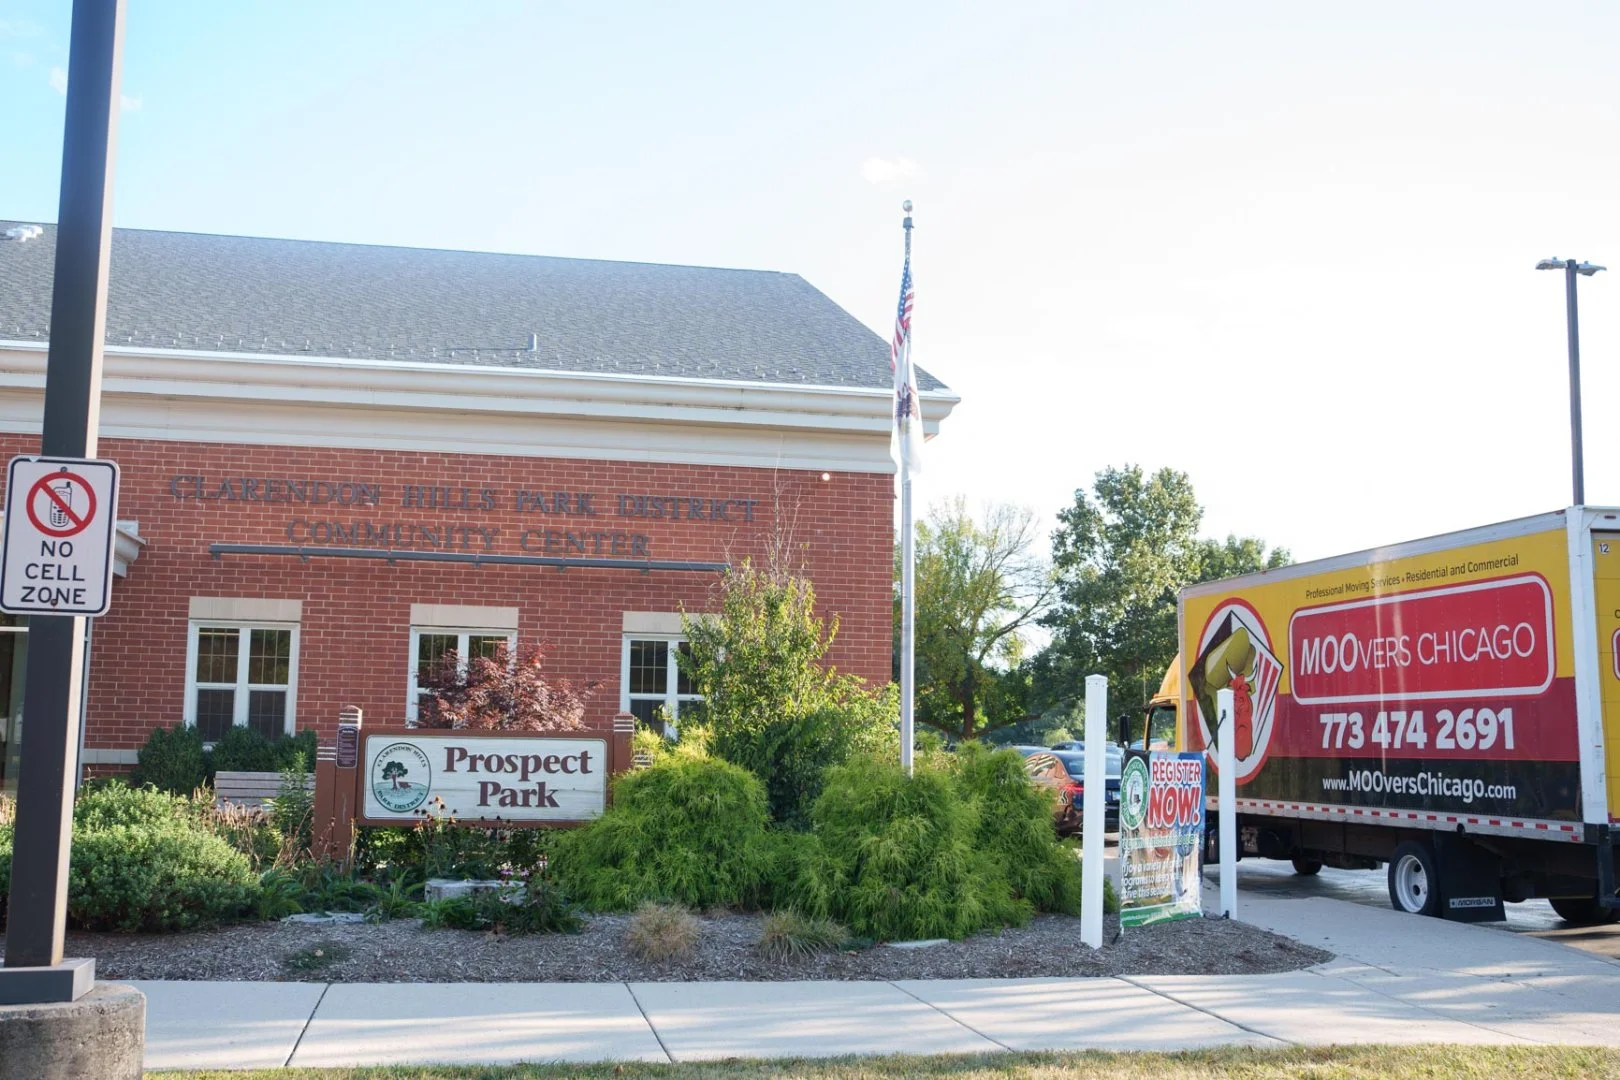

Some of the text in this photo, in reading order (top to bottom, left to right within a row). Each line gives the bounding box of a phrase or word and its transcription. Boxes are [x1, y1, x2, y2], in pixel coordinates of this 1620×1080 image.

[169, 475, 760, 523] CLARENDON HILLS PARK DISTRICT
[40, 540, 74, 558] NO
[287, 518, 650, 556] COMMUNITY CENTER
[1599, 543, 1609, 553] 12
[25, 563, 85, 582] CELL
[1305, 554, 1519, 599] Professional Moving Services Residential and Commercial
[20, 586, 87, 605] ZONE
[1417, 622, 1535, 665] CHICAGO
[1319, 707, 1515, 750] 773 474 2691
[377, 746, 412, 767] CLARENDON
[413, 750, 427, 768] HILLS
[443, 746, 593, 782] Prospect
[1152, 761, 1201, 782] REGISTER
[377, 790, 392, 807] PARK
[477, 781, 560, 809] Park
[1322, 770, 1516, 804] www.MOOversChicago.com
[1149, 786, 1200, 826] NOW!
[1458, 898, 1494, 906] MORGAN
